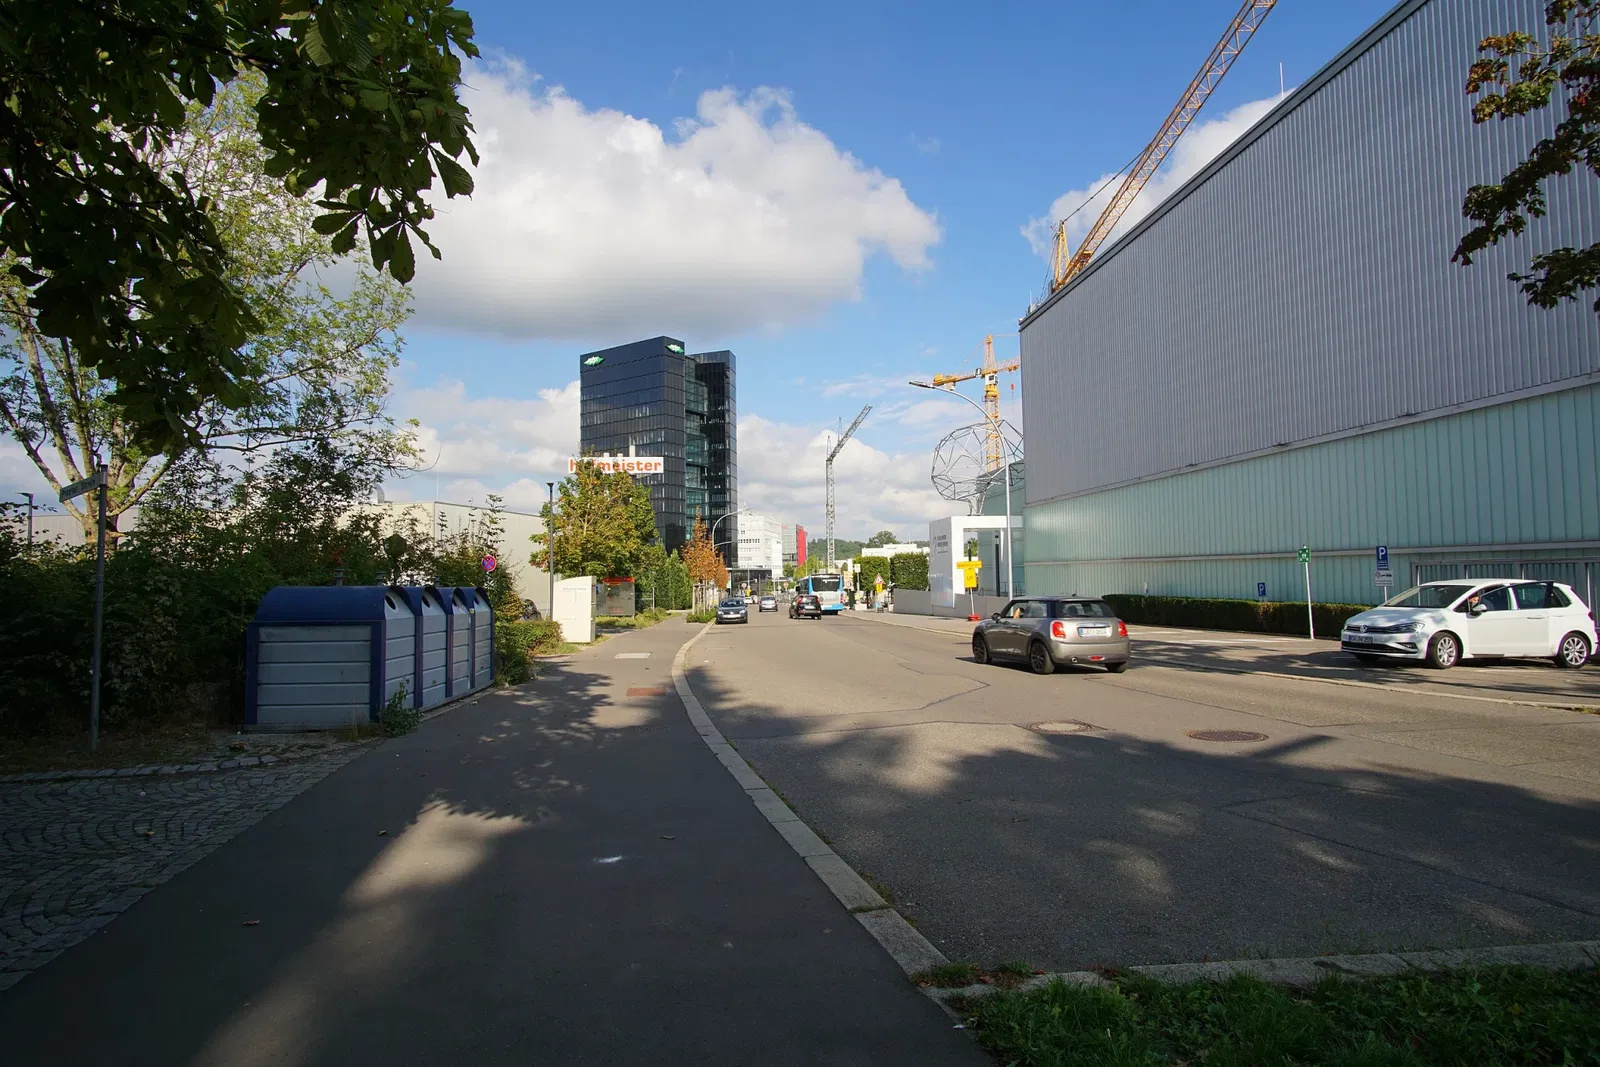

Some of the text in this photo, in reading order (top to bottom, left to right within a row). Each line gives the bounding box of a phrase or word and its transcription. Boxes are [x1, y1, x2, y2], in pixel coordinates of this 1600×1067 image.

[570, 458, 661, 472] hmeister
[1378, 547, 1386, 560] P
[1259, 584, 1264, 594] P
